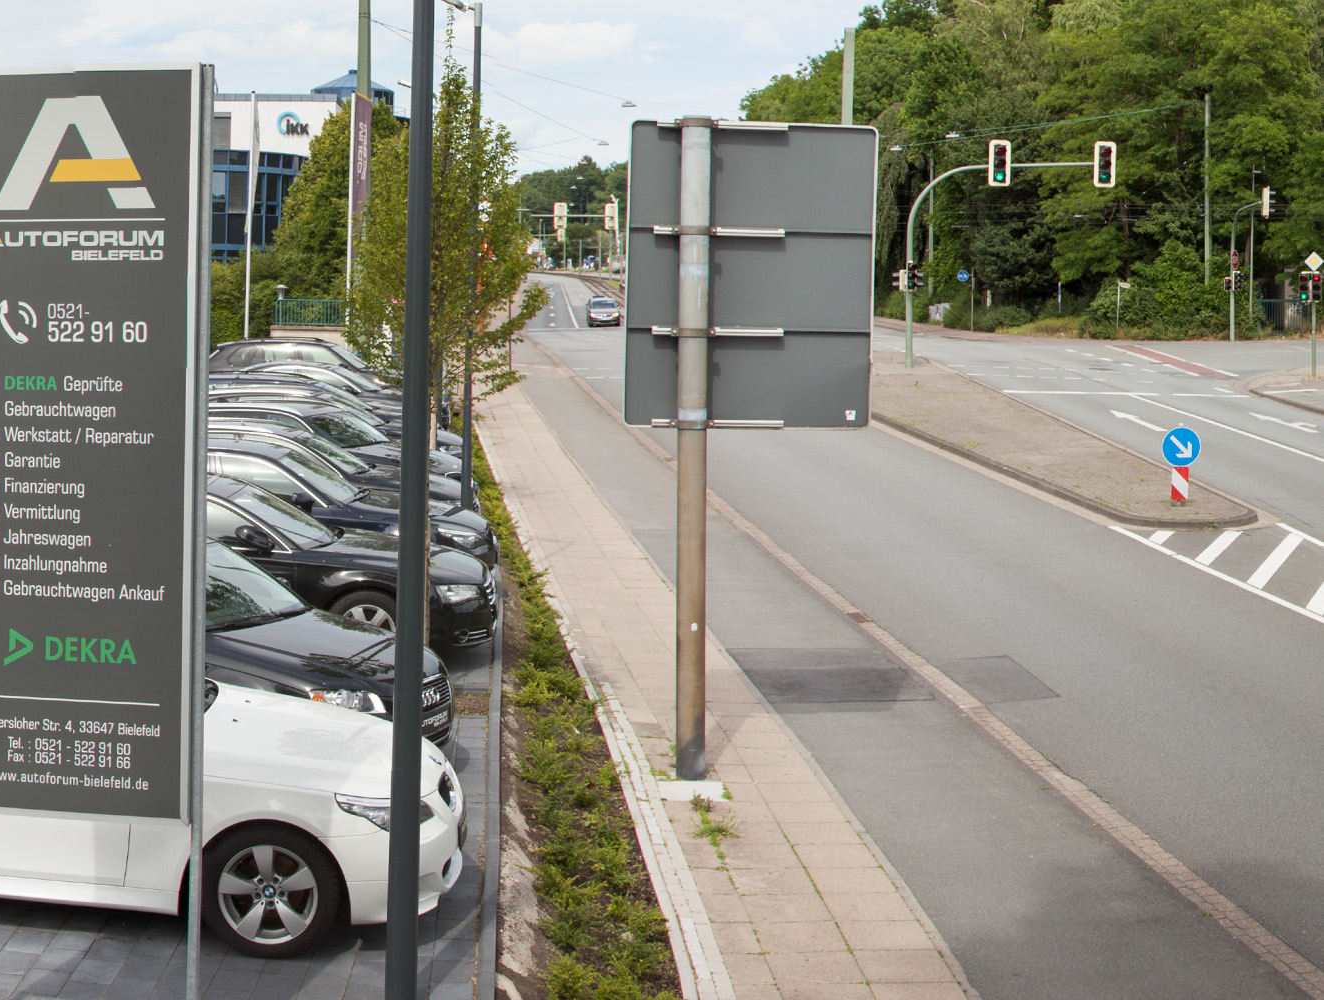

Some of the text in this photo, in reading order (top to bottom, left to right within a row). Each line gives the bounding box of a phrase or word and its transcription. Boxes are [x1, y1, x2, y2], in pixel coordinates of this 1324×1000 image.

[71, 249, 164, 261] BIELEFELD
[47, 303, 90, 319] 0521-
[47, 321, 148, 343] 522 91 60
[4, 375, 123, 395] DEKRA Geprüfte
[4, 400, 116, 421] Gebrauchtwagen
[4, 426, 72, 443] Werkstatt
[85, 428, 154, 447] Reparatur
[4, 451, 61, 469] Garantie
[4, 477, 85, 498] Finanzierung
[3, 503, 81, 524] Vermittlung
[3, 528, 91, 550] Jahreswagen
[4, 554, 107, 575] Inzahlungnahme
[3, 580, 165, 602] Gebrauchtwagen Ankauf
[45, 635, 137, 665] DEKRA
[42, 718, 61, 732] Str.
[65, 720, 75, 734] 4,
[79, 721, 114, 734] 33647
[118, 723, 160, 737] Bielefeld
[8, 736, 23, 749] Tel.
[35, 738, 62, 751] 0521
[74, 740, 95, 754] 522
[98, 742, 112, 754] 91
[116, 743, 131, 756] 60
[7, 750, 24, 763] Fax
[35, 751, 62, 765] 0521
[74, 754, 95, 767] 522
[98, 755, 112, 768] 91
[116, 756, 131, 769] 66
